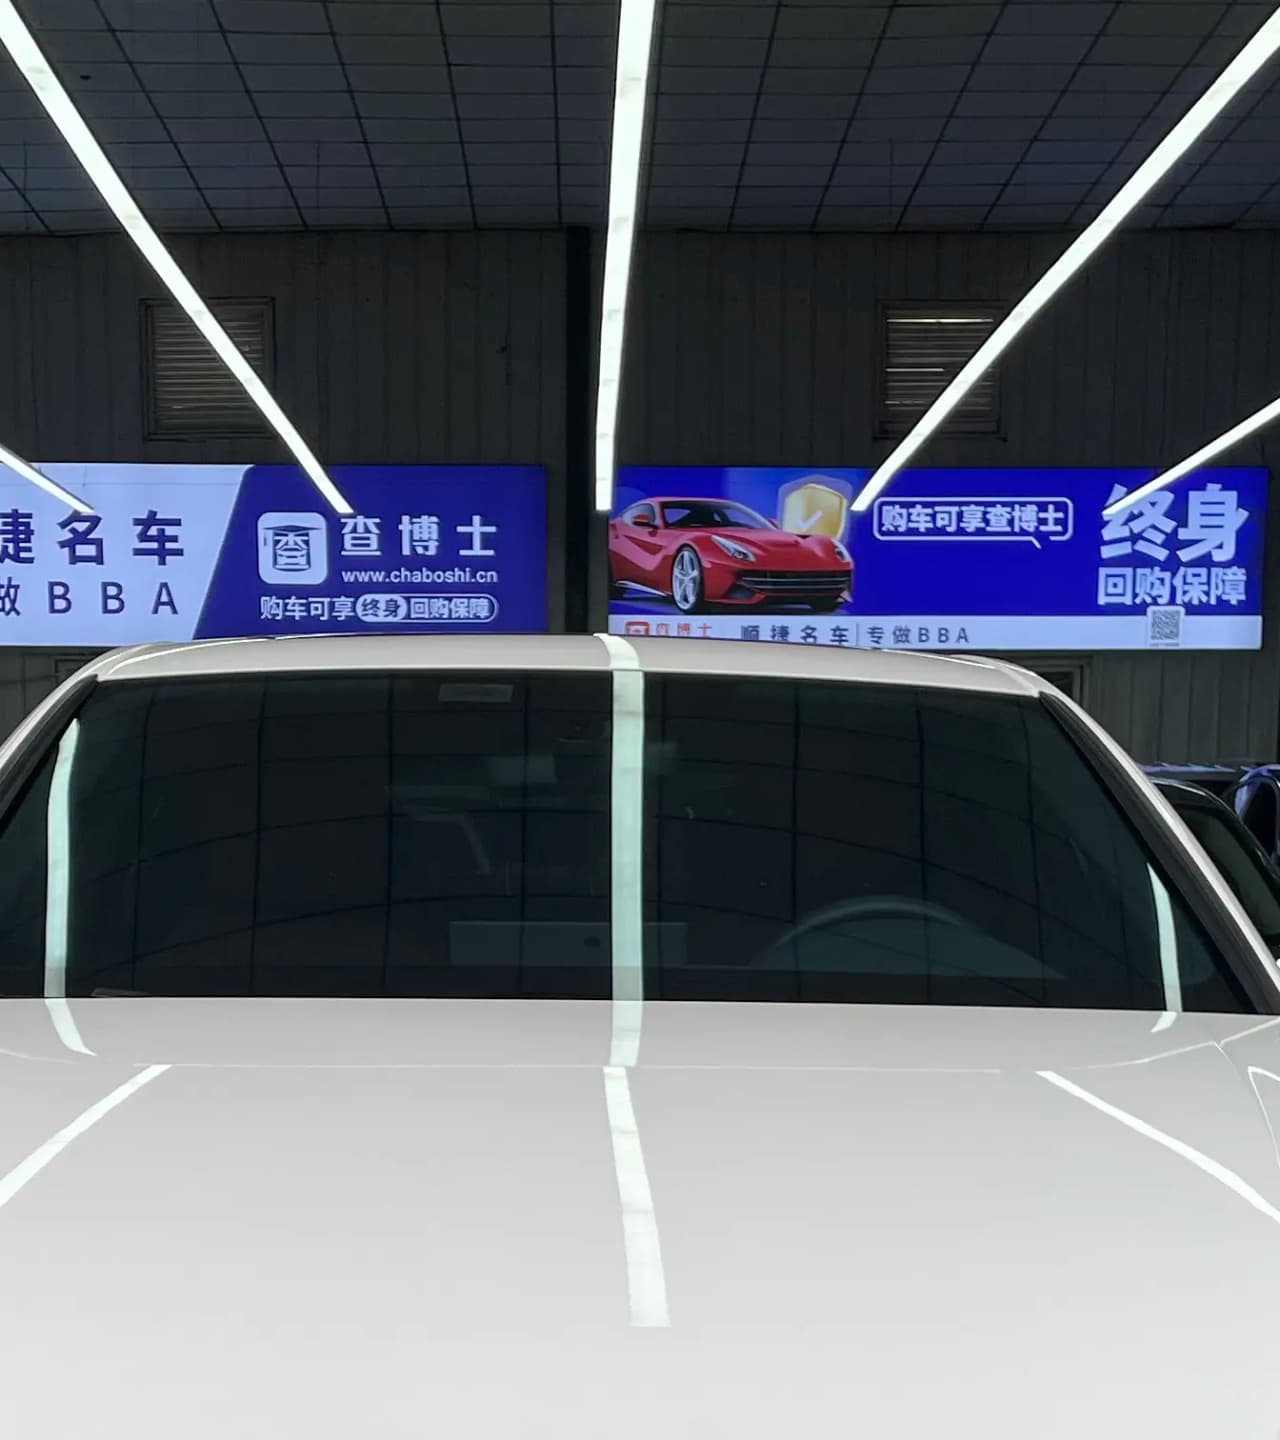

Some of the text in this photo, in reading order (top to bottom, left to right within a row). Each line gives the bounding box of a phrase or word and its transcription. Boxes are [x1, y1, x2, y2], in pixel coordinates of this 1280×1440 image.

[340, 512, 498, 559] 查博士
[881, 503, 1066, 535] 购车可享查博士
[1099, 482, 1249, 563] 终身
[341, 566, 499, 585] www.chaboshi.cn
[1096, 565, 1249, 607] 回购保障
